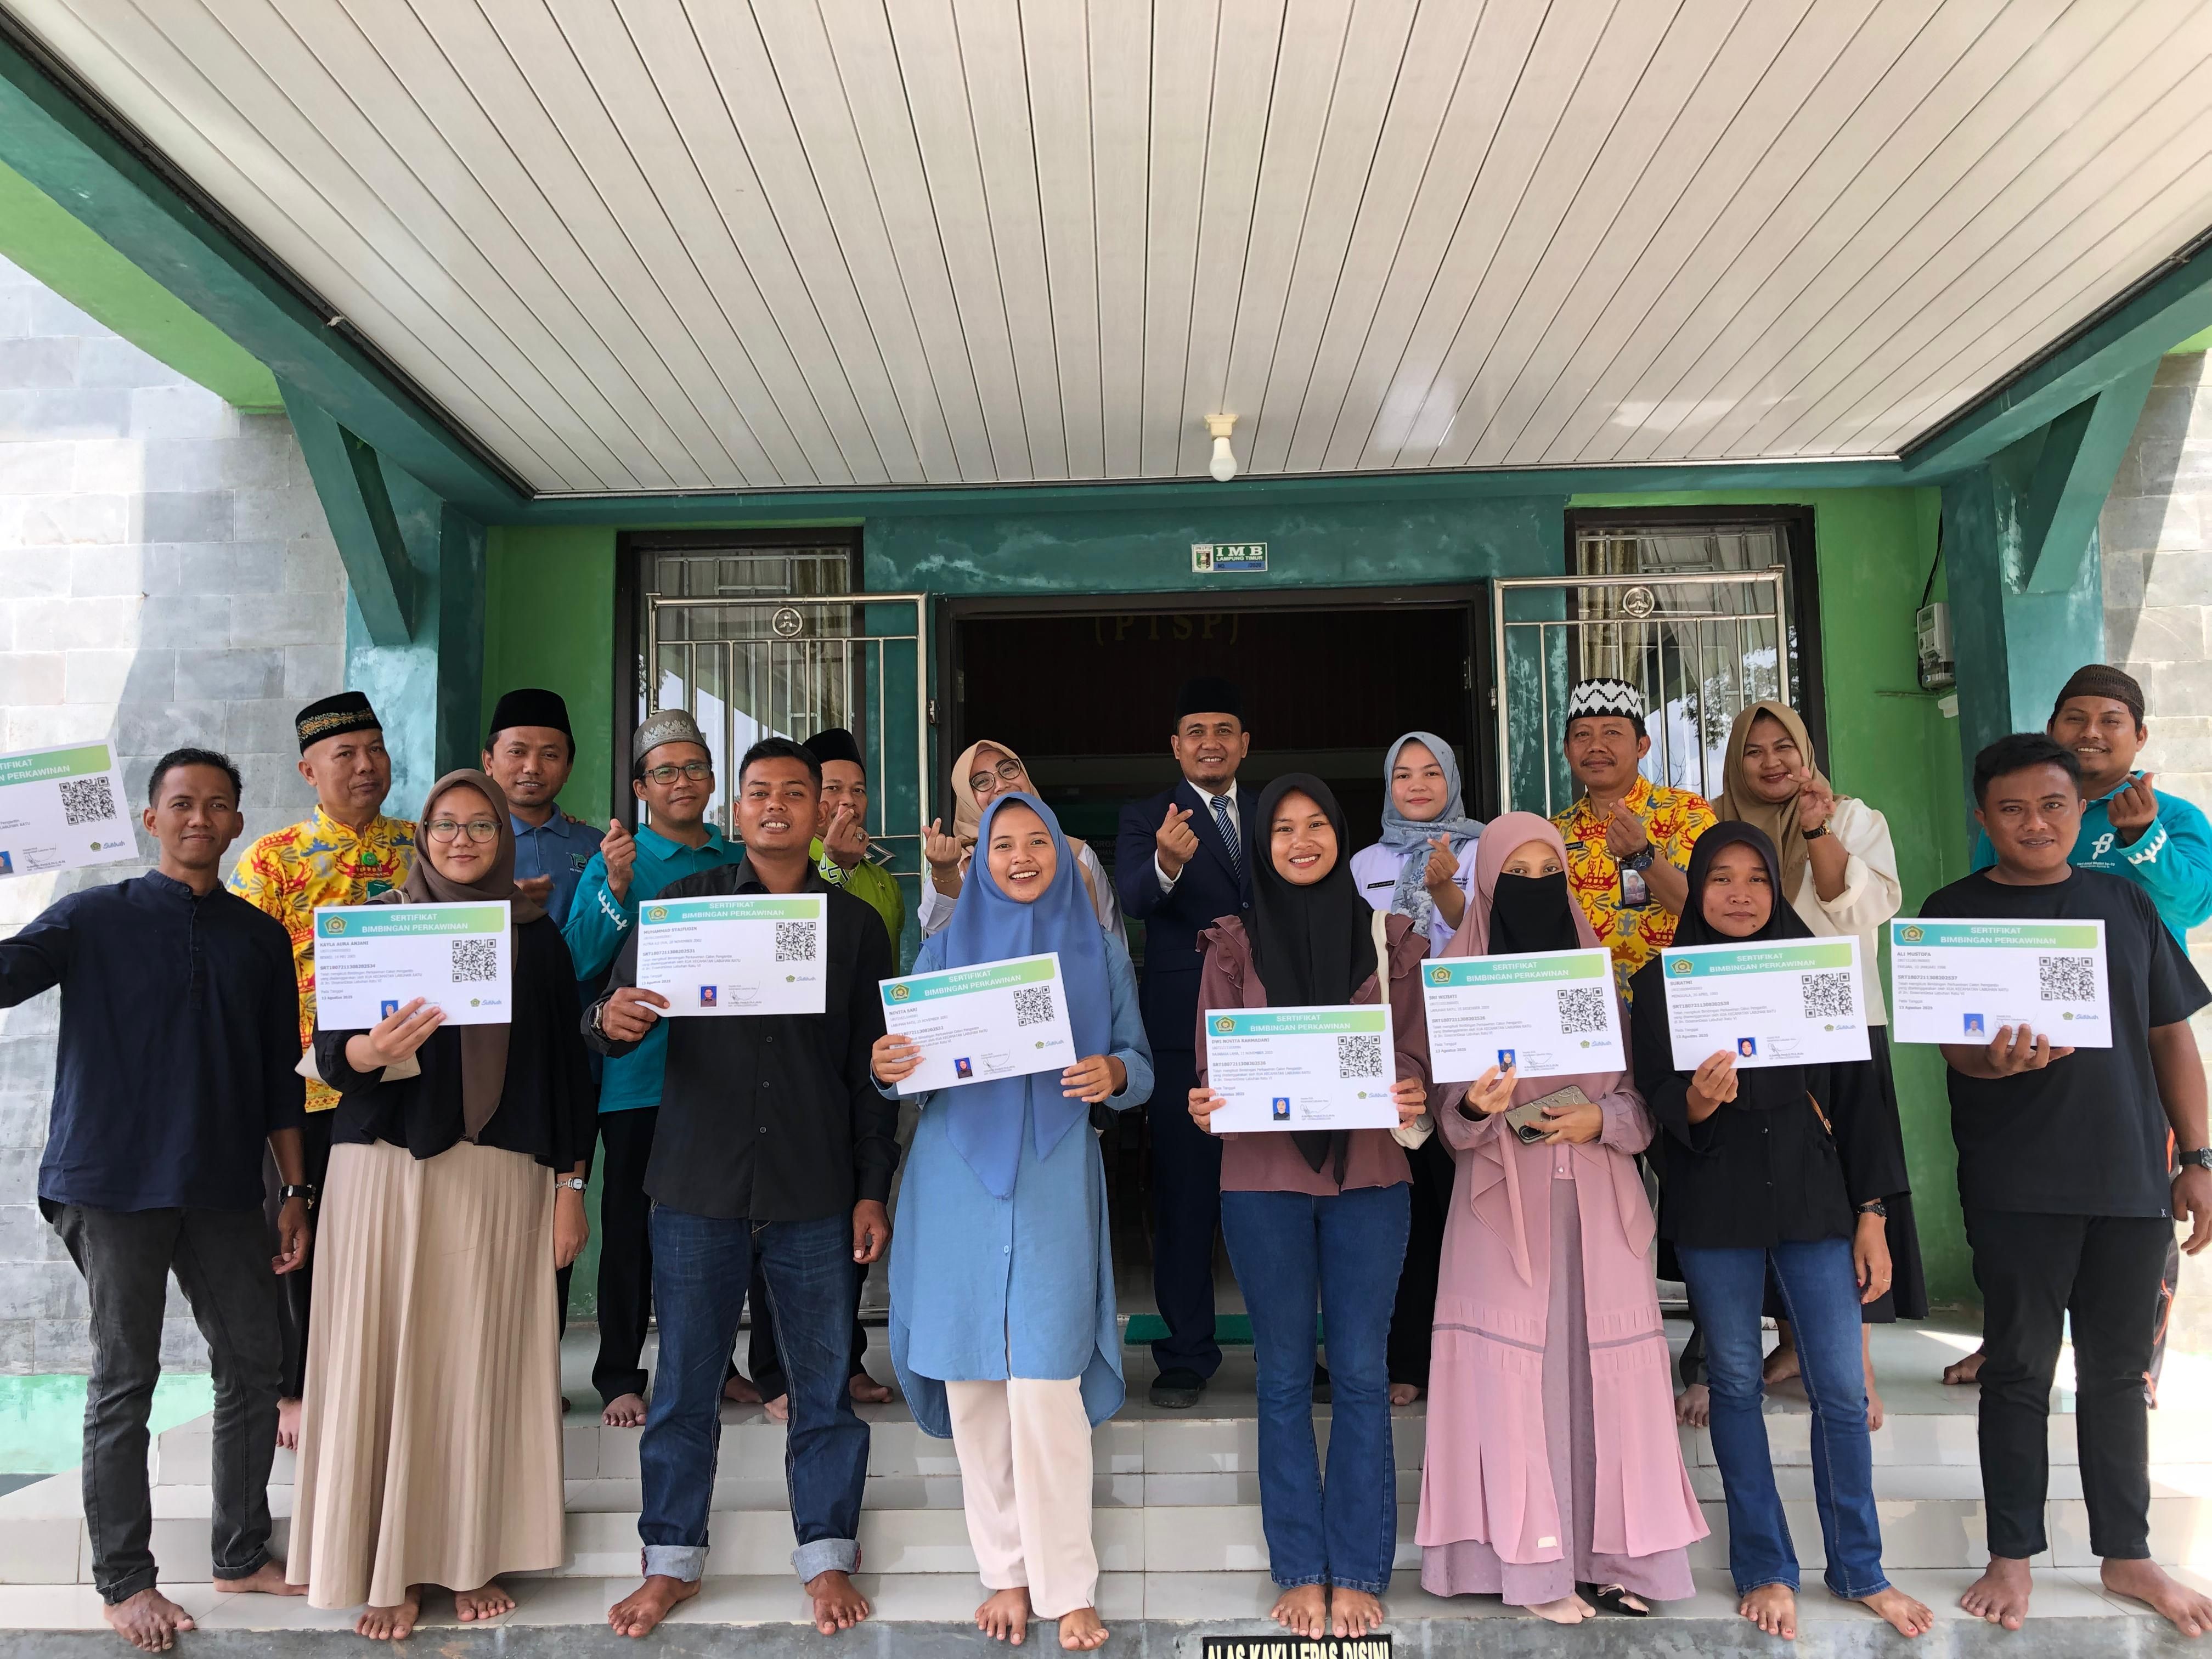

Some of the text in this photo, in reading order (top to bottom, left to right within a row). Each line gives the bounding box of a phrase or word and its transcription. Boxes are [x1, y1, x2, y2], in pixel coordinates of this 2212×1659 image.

[8, 765, 70, 780] PERKAWINAN
[730, 909, 784, 917] PERKAWINAN
[362, 922, 467, 933] BIMBINGAN PERKAWINAN
[1736, 953, 1783, 961] SERTIFIKAT
[1492, 962, 1538, 970] SERTIFIKAT
[1709, 960, 1815, 972] BIMBINGAN PERKAWINAN
[948, 970, 992, 982] SERTIFIKAT
[1466, 969, 1568, 981] BIMBINGAN PERKAWINAN
[924, 974, 1022, 996] BIMBINGAN PERKAWINAN
